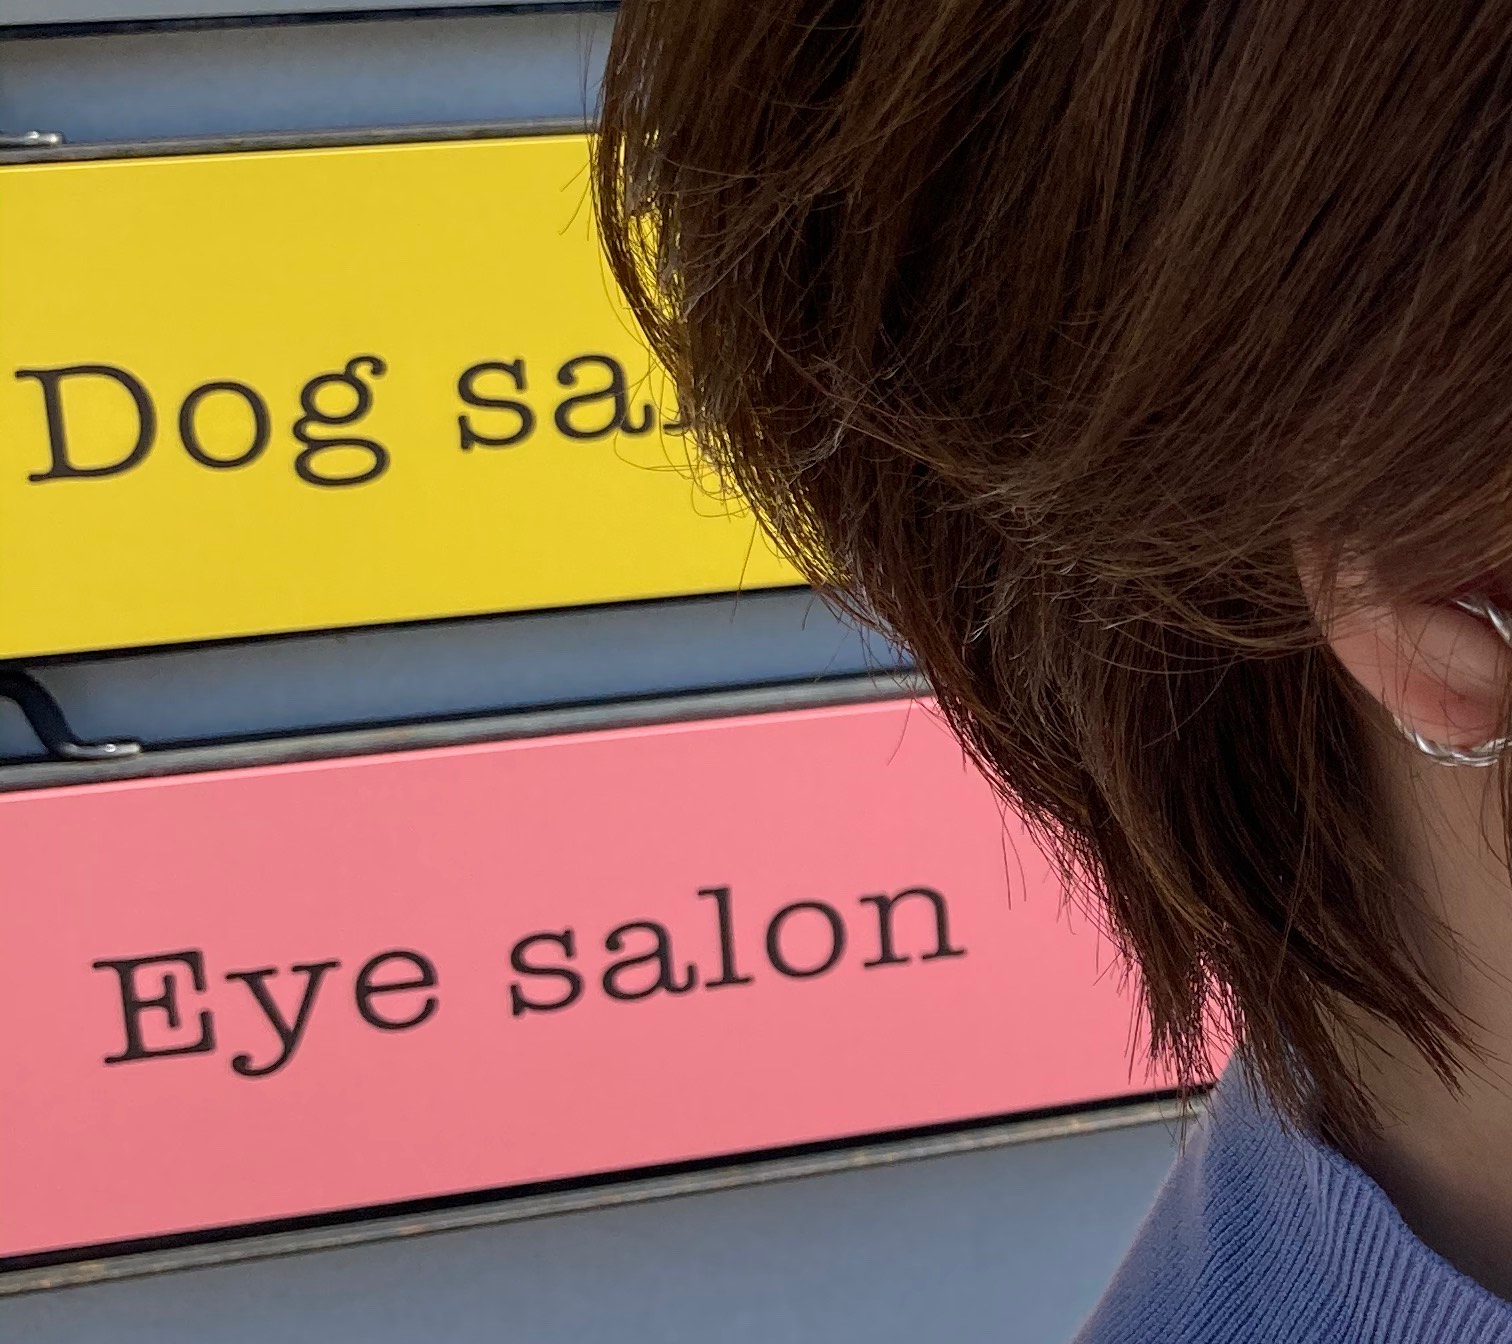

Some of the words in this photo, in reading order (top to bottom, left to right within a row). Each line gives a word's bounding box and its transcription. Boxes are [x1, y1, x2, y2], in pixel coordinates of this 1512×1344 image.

[14, 354, 391, 489] Dog
[457, 353, 700, 453] sa
[91, 946, 441, 1080] Eye
[508, 883, 968, 1019] salon
